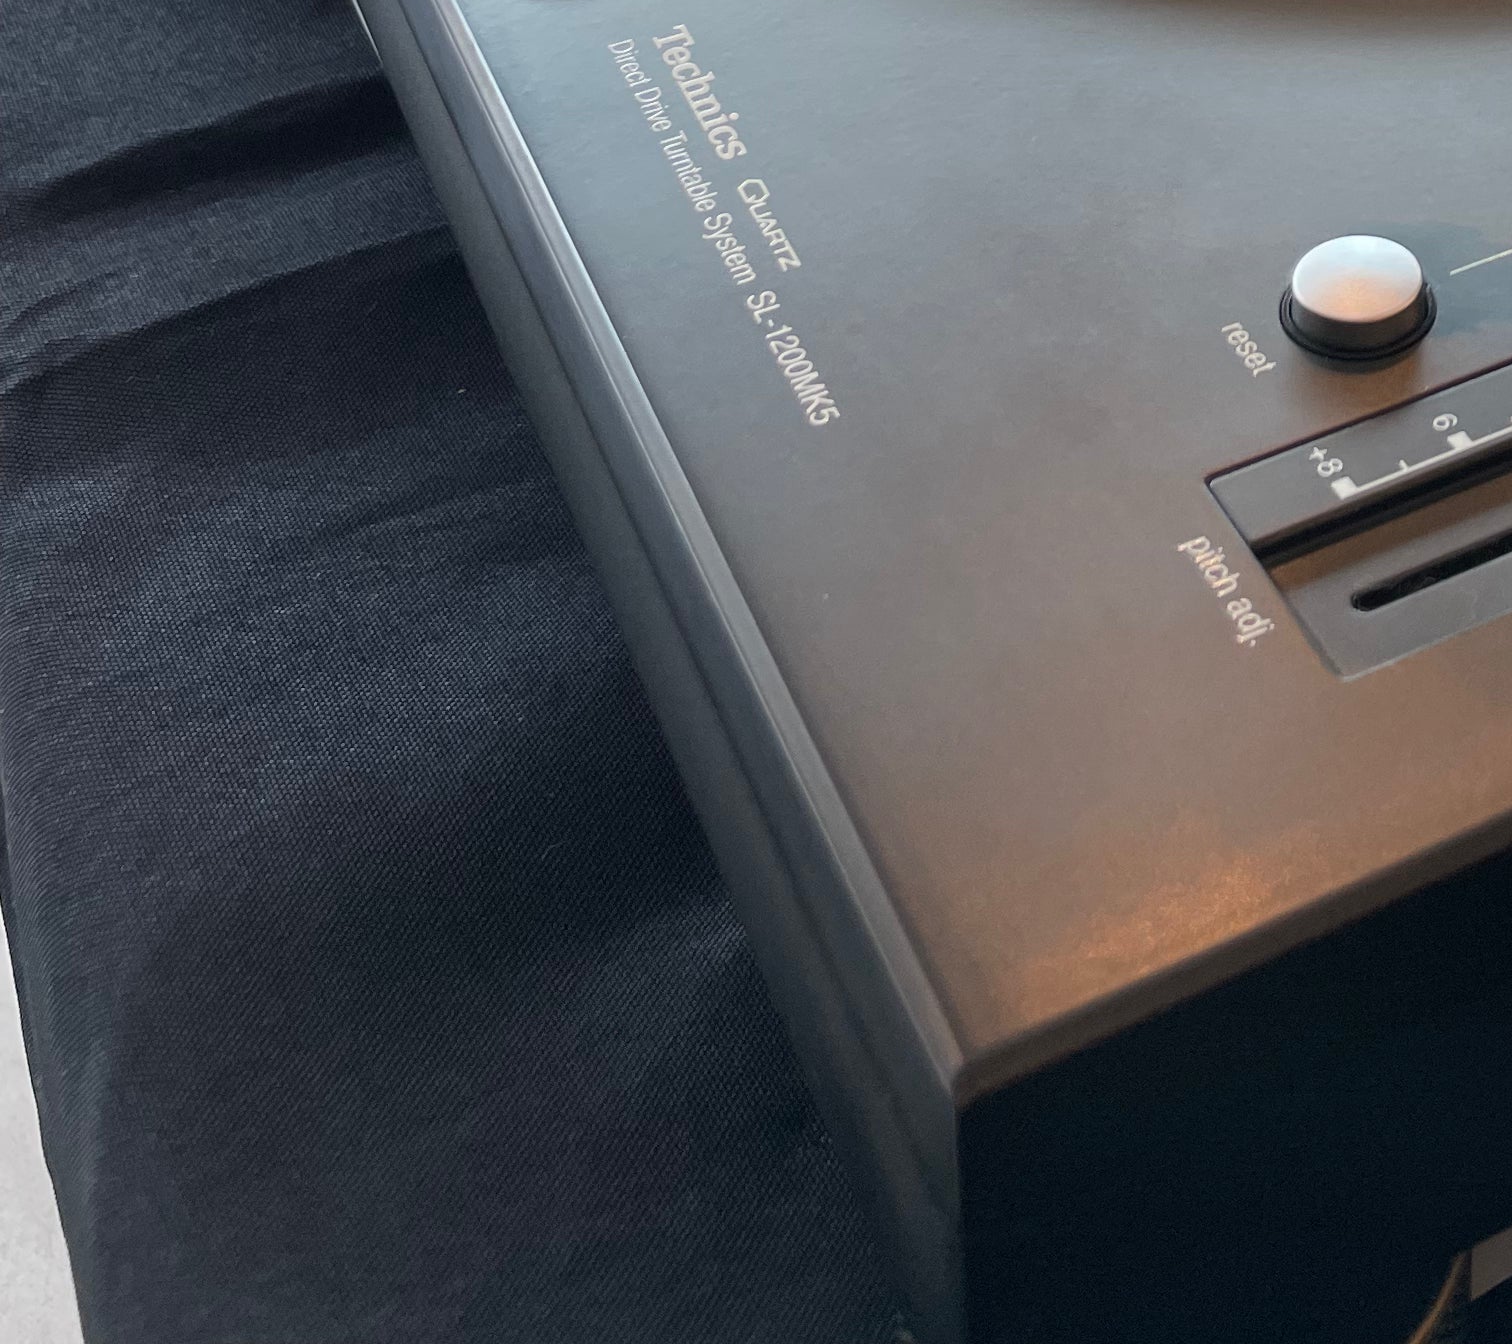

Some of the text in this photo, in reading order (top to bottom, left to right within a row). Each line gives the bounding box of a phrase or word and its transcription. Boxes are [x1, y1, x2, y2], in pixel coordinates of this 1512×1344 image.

[652, 24, 801, 272] Technics QUARTZ
[607, 38, 841, 427] Direct Drive Turntable System SL-1200MK5
[1222, 322, 1276, 377] reset
[1309, 447, 1343, 477] +8
[1432, 413, 1458, 432] 6
[1177, 536, 1240, 598] pitch
